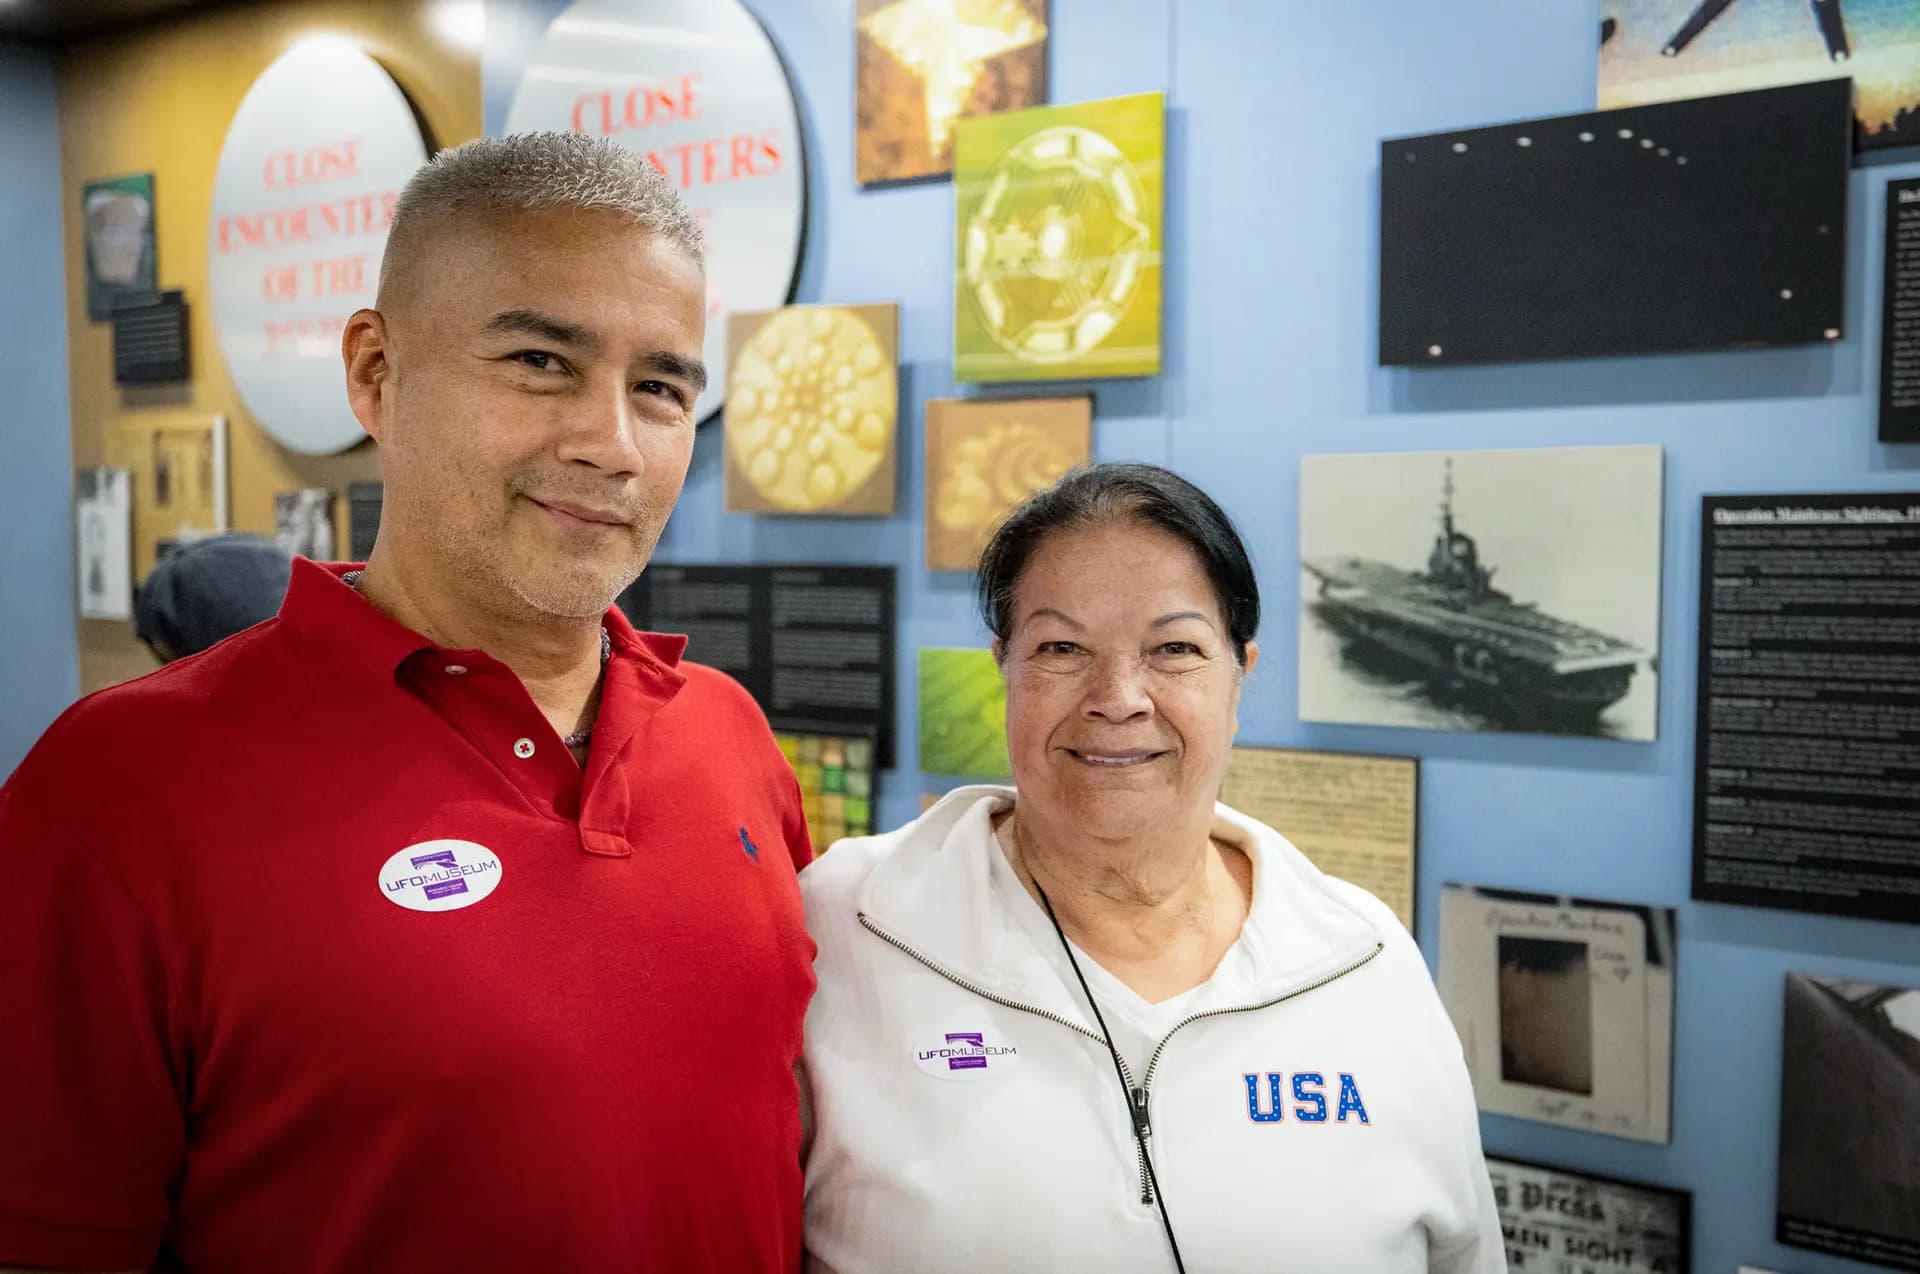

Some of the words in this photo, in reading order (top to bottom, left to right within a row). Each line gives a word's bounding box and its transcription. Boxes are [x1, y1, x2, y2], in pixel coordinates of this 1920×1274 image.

[572, 74, 702, 134] CLOSE
[262, 135, 362, 191] CLOSE
[647, 129, 782, 188] NTERS
[217, 189, 399, 256] ENCOUNTER
[262, 264, 300, 304] OF
[311, 256, 367, 298] THE
[386, 860, 498, 892] UFOMUSEUM
[919, 1046, 1017, 1061] UFOMUSEUM
[1242, 1071, 1372, 1126] USA
[1564, 1236, 1634, 1266] SIGHT
